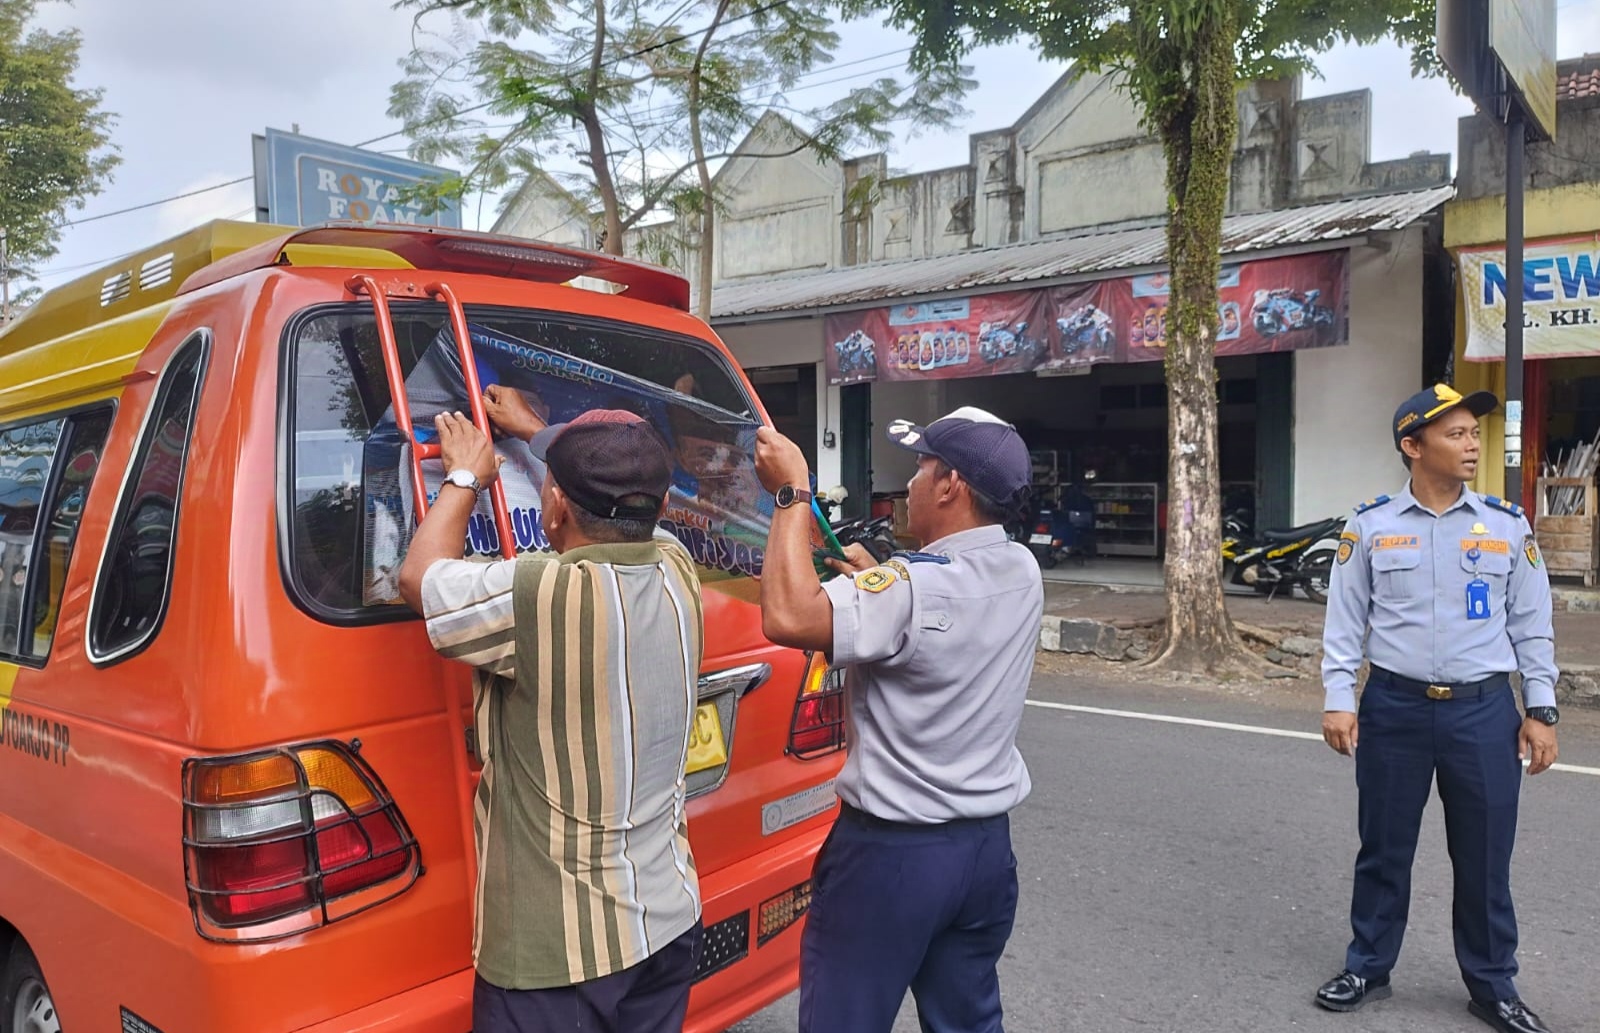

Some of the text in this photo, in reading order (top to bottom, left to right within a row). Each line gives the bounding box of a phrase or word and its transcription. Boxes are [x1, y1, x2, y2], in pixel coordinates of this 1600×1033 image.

[328, 196, 417, 226] FOAM
[1484, 254, 1600, 305] NEW
[1549, 308, 1598, 326] KH.
[54, 721, 70, 767] PP
